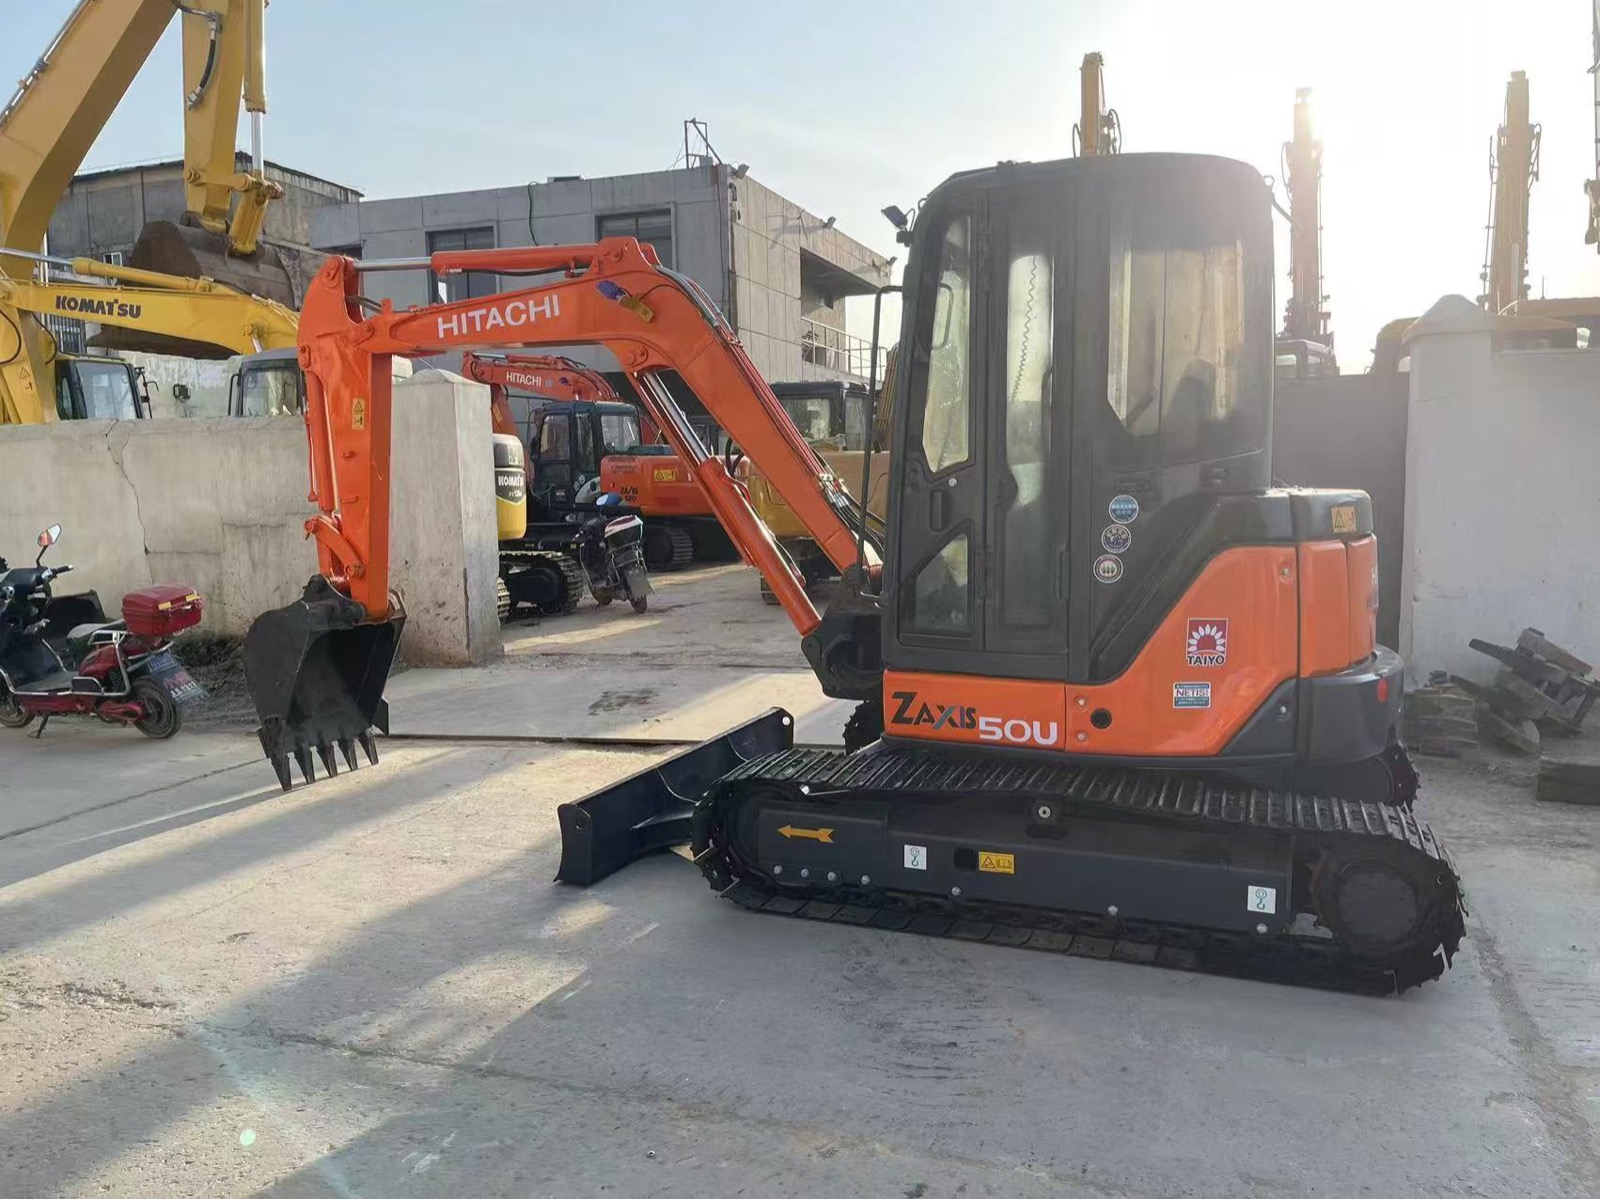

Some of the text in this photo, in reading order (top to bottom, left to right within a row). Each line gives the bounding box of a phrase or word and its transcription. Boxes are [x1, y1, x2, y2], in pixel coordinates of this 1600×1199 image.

[55, 296, 141, 318] KOMATSU
[437, 294, 560, 339] HITACHI
[506, 371, 542, 387] HITACHI
[1187, 655, 1225, 666] TAIYO
[1176, 689, 1205, 697] NETIS
[891, 691, 1058, 745] ZAXIS 50U
